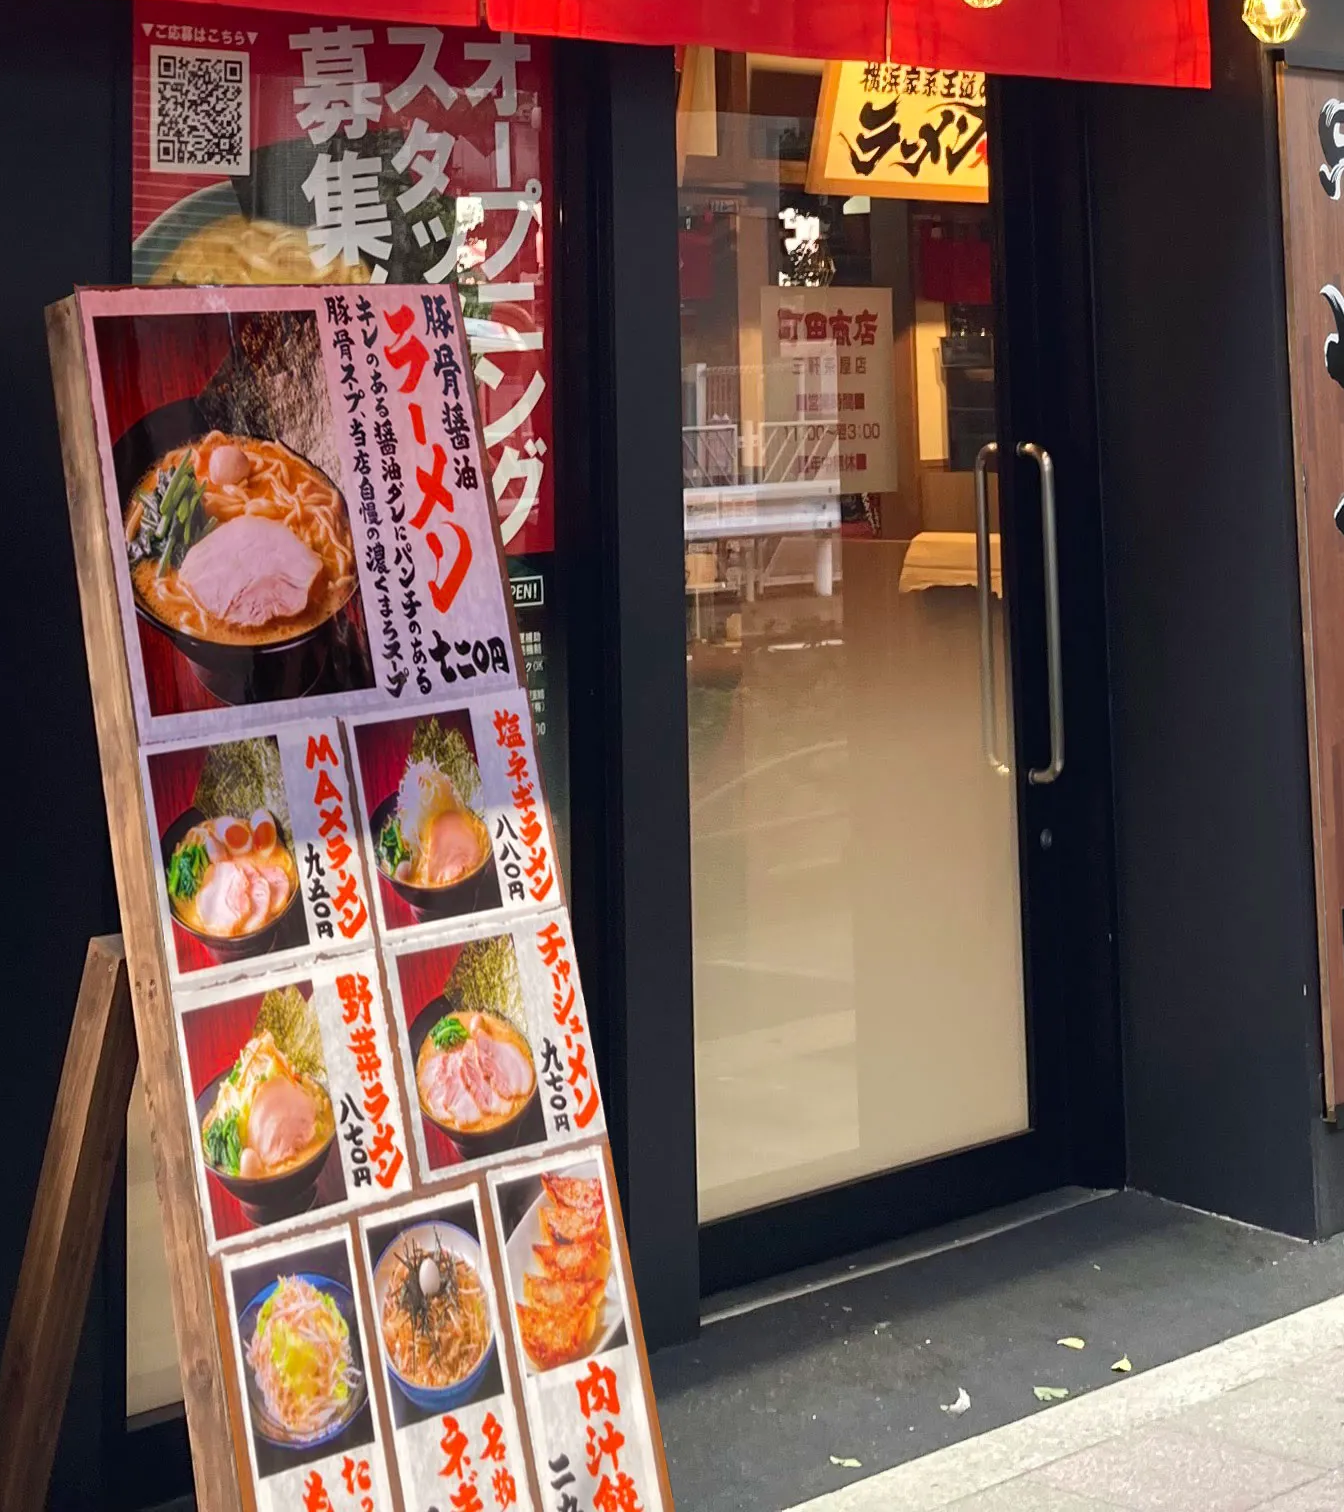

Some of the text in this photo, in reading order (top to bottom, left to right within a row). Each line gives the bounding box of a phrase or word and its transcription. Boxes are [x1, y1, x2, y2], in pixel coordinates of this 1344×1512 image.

[385, 26, 468, 288] スタッ
[383, 304, 474, 614] ラーメン
[422, 294, 478, 490] 豚骨醤油
[305, 734, 367, 939] MAXラーメン
[492, 709, 554, 902] 塩ネギラーメン
[335, 972, 404, 1189] 野菜ラーメン
[537, 921, 599, 1129] チャーシューメン
